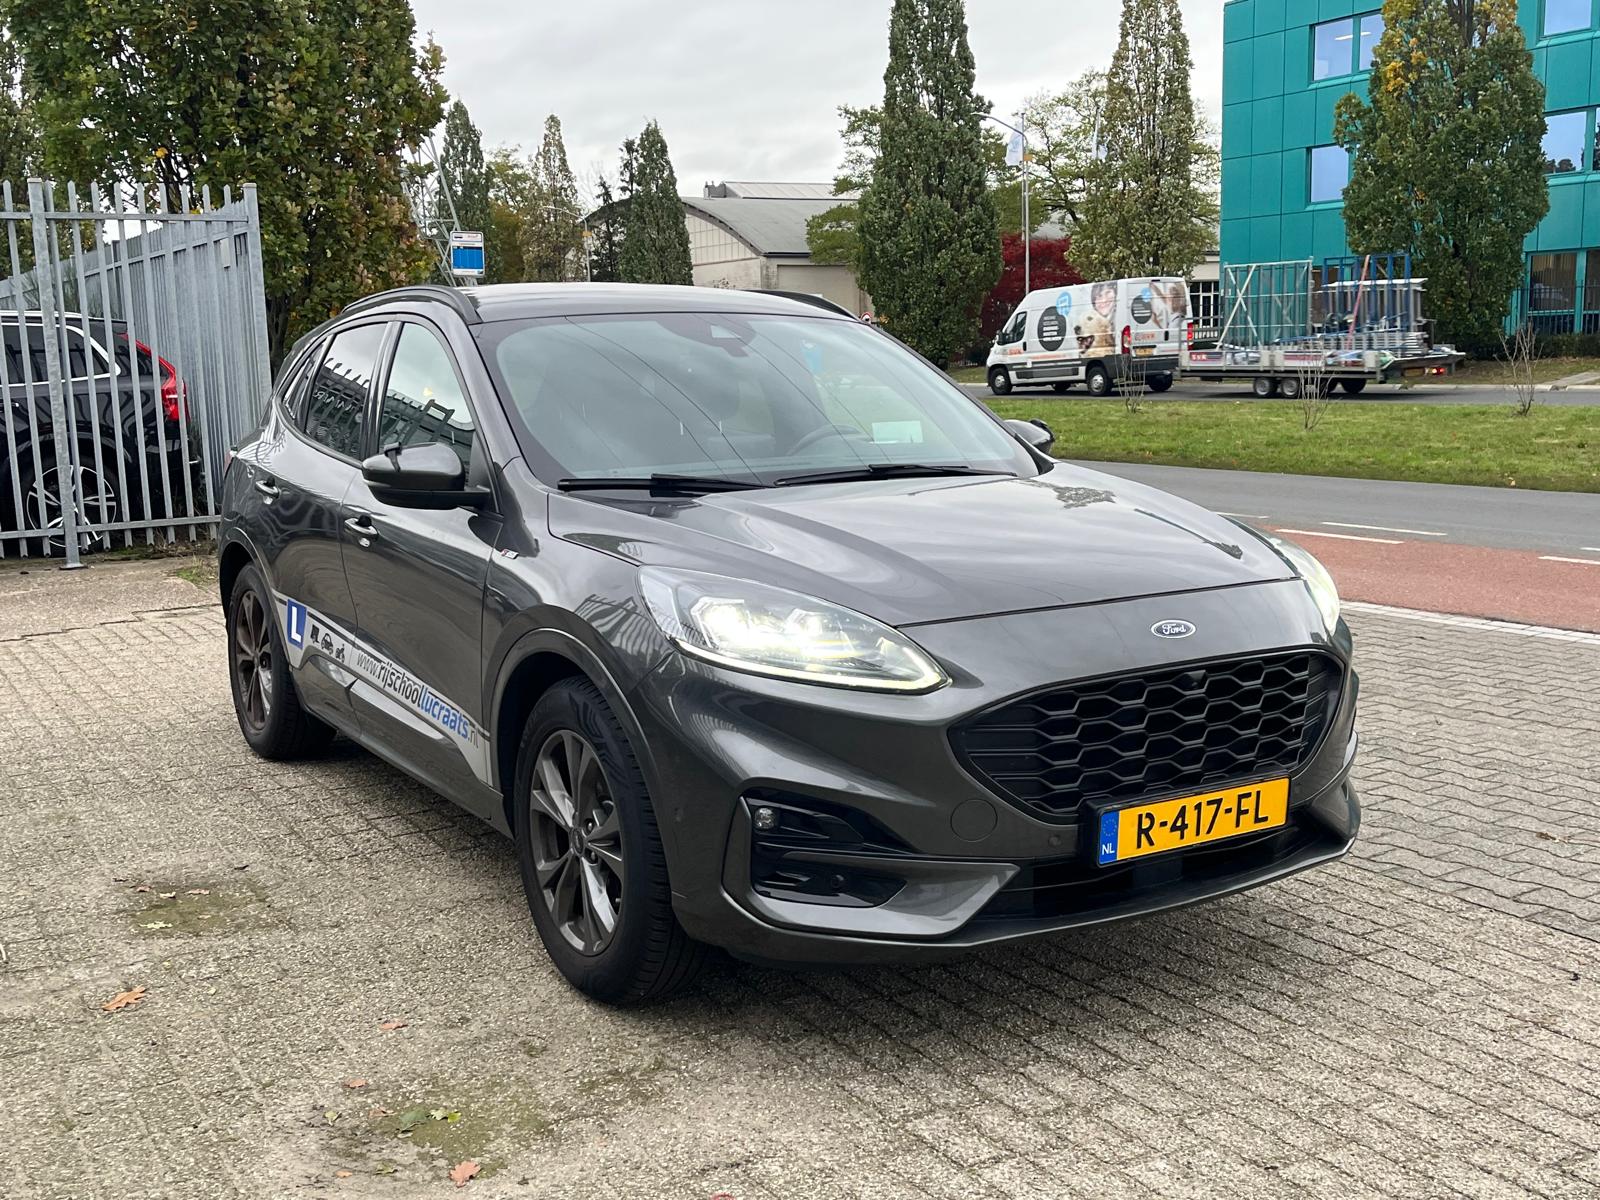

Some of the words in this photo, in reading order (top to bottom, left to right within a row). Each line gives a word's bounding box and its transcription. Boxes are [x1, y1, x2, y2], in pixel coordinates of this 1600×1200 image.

[291, 606, 302, 642] L
[1161, 622, 1187, 635] Ford
[356, 651, 479, 749] www.rijschoollucraats.nl
[1136, 790, 1269, 849] R-417-FL
[1101, 843, 1115, 855] NL
